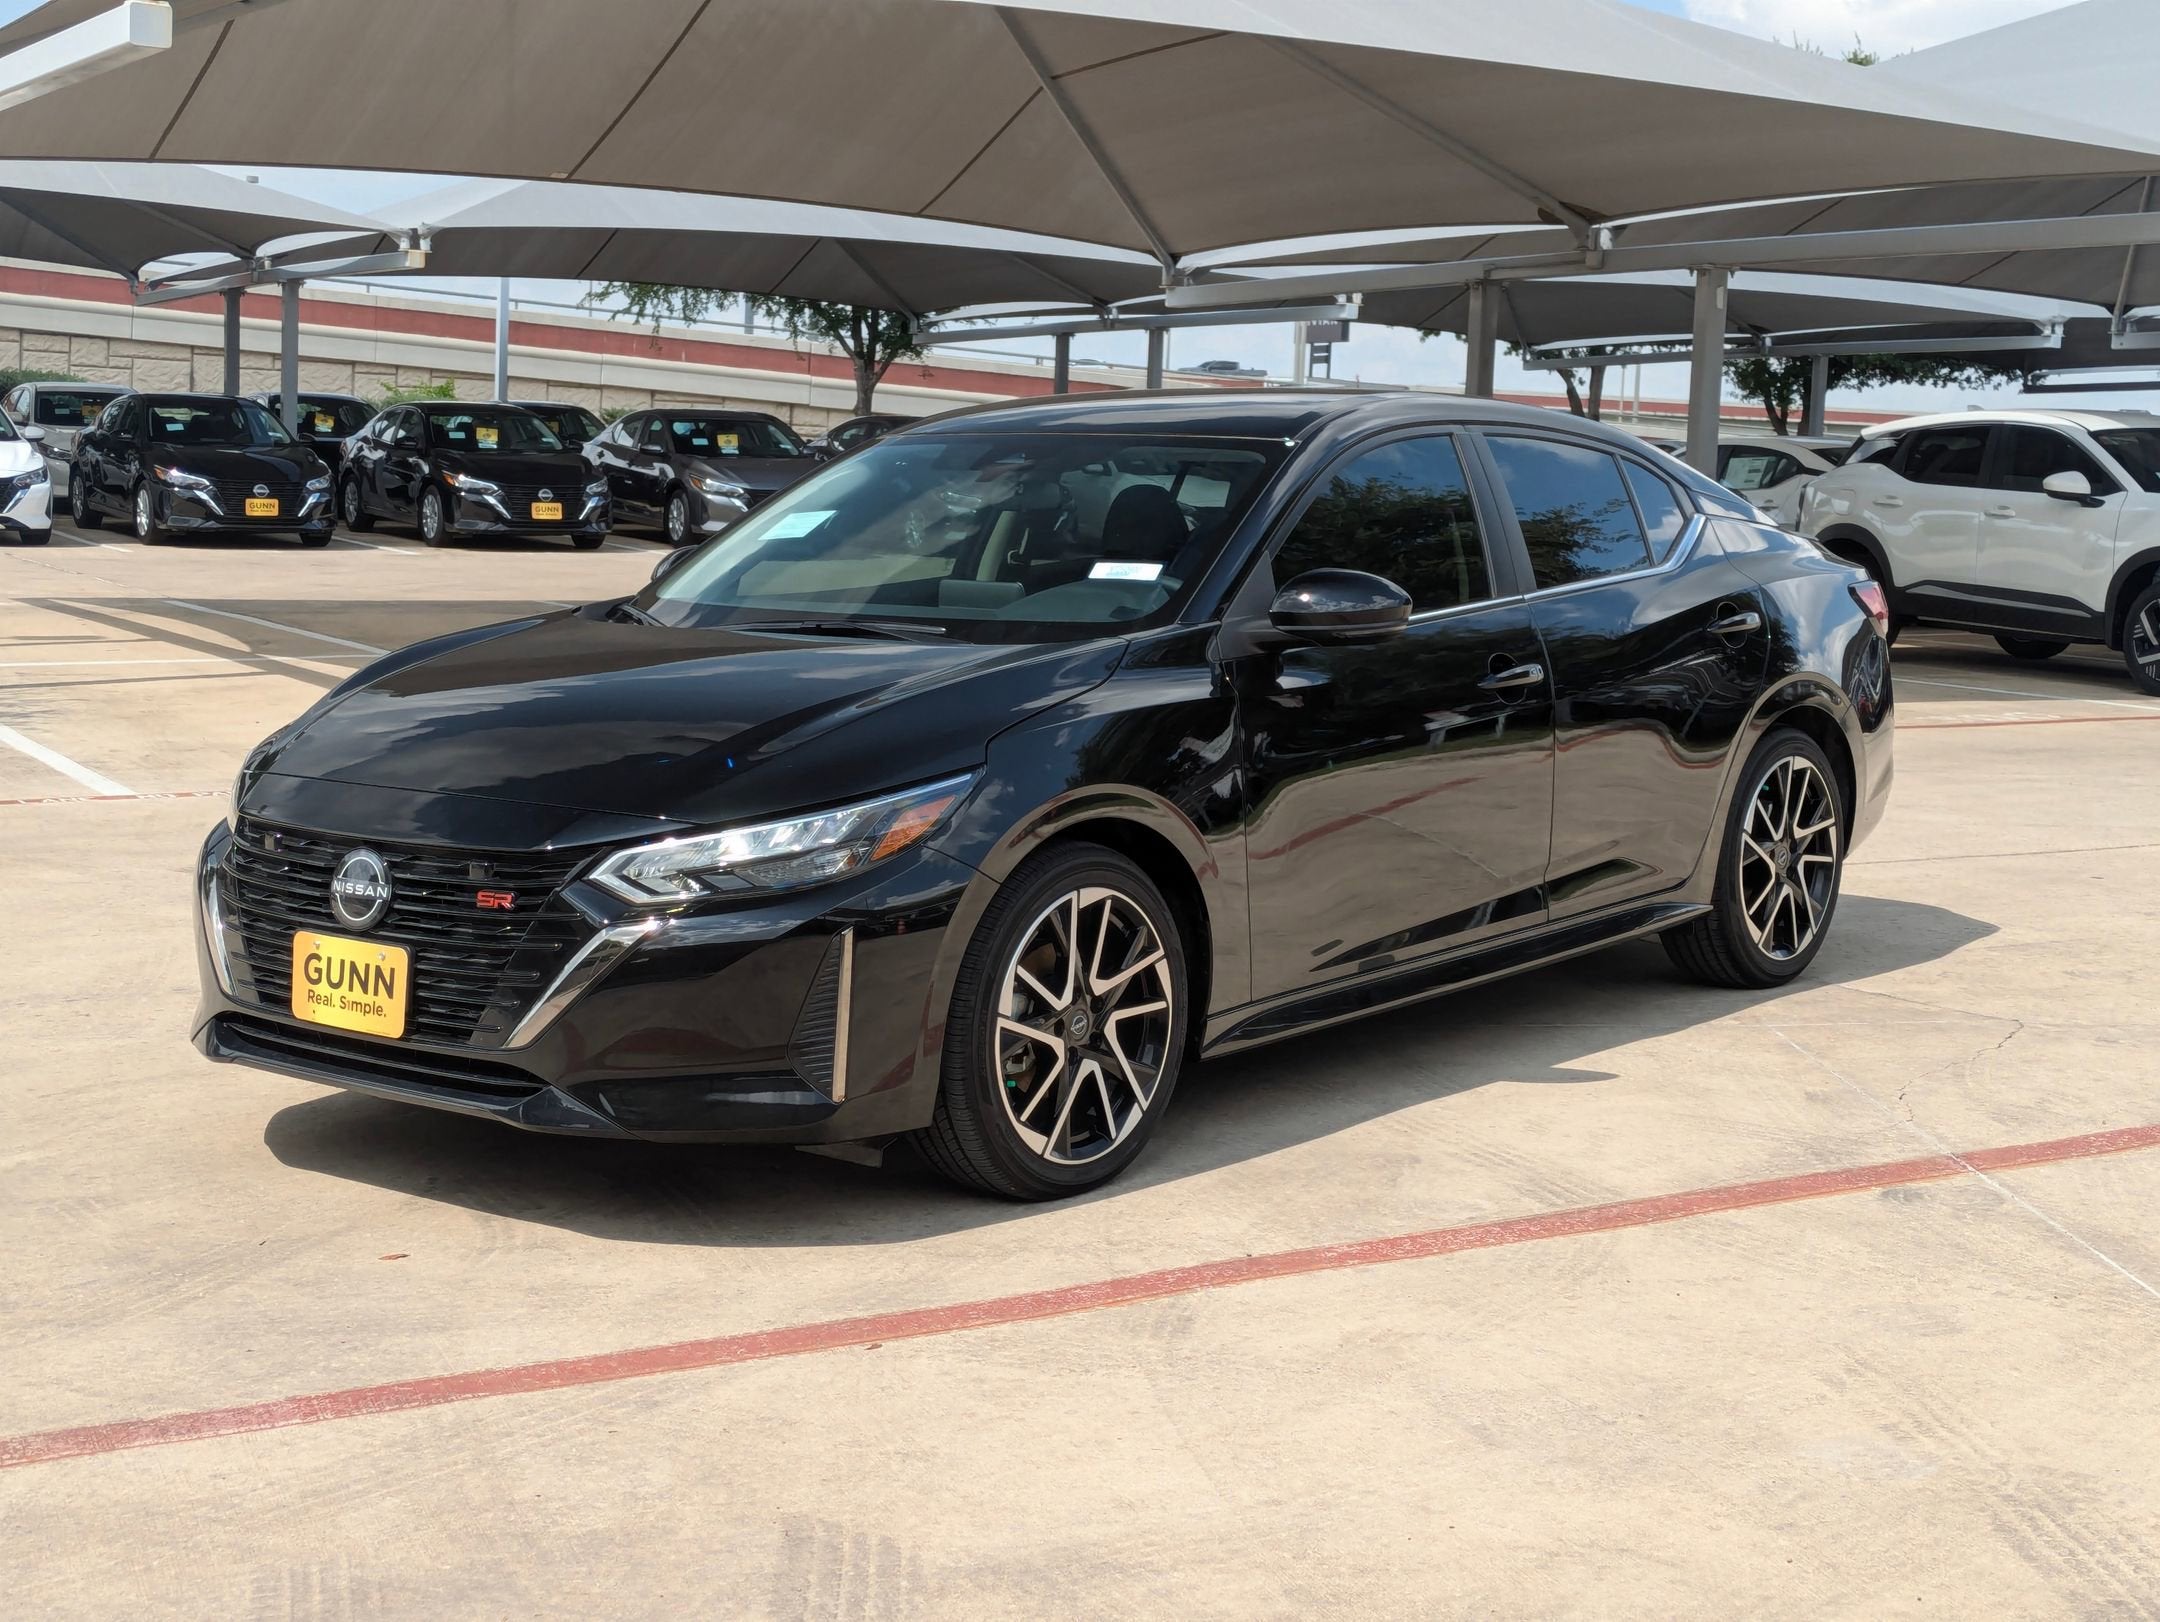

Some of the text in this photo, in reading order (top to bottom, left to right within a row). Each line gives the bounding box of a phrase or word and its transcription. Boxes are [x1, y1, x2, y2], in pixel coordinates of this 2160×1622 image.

[333, 880, 388, 898] NISSAN
[475, 890, 515, 910] SR
[303, 952, 396, 1000] GUNN
[307, 989, 387, 1018] Real. Simple.
